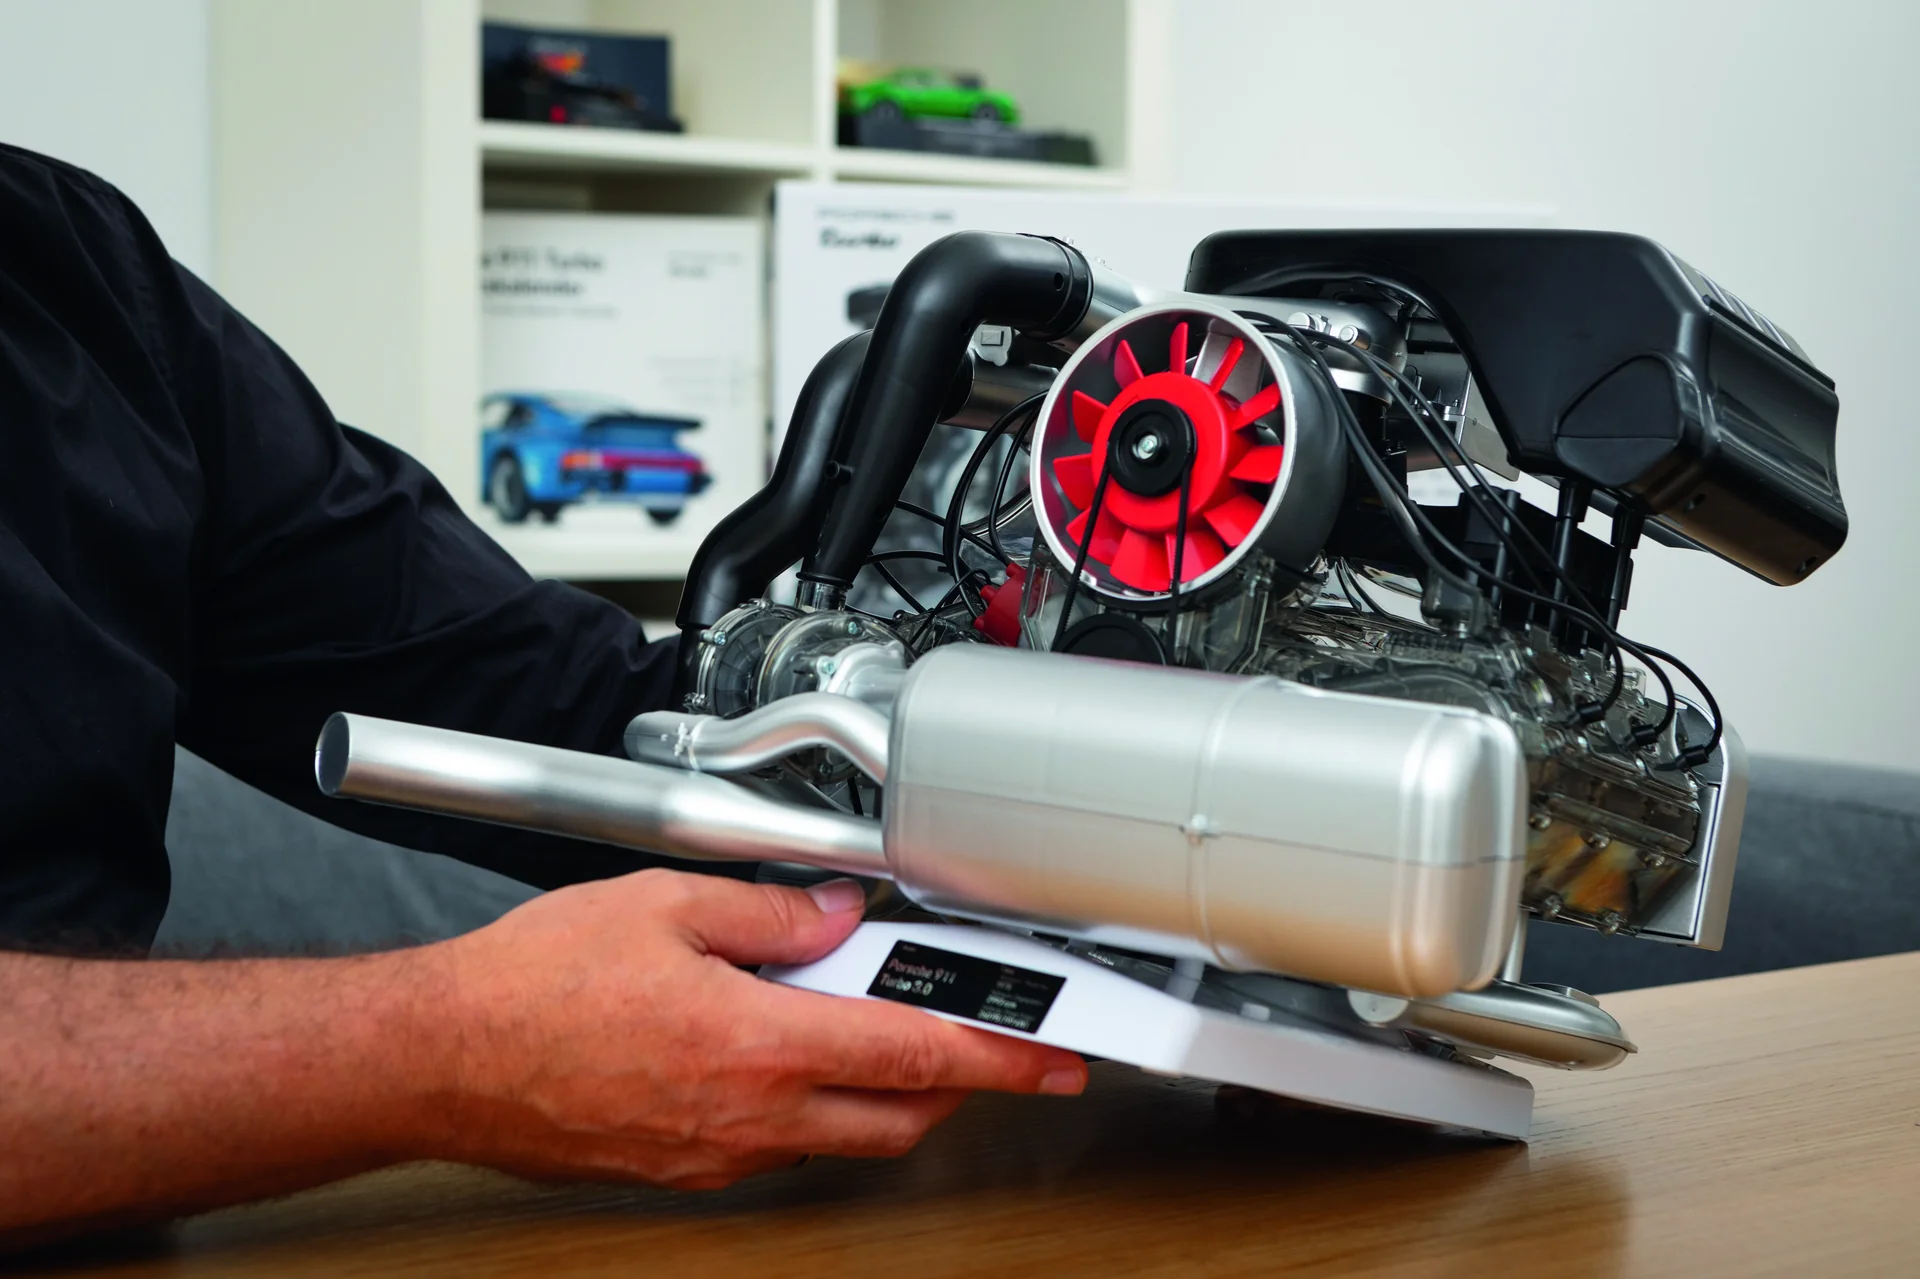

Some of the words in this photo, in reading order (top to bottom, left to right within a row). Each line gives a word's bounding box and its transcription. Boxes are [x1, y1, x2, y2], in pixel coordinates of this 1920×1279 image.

[888, 958, 933, 979] Porsche
[934, 967, 957, 985] 911
[880, 973, 912, 992] Turbo
[911, 979, 934, 996] 3.0
